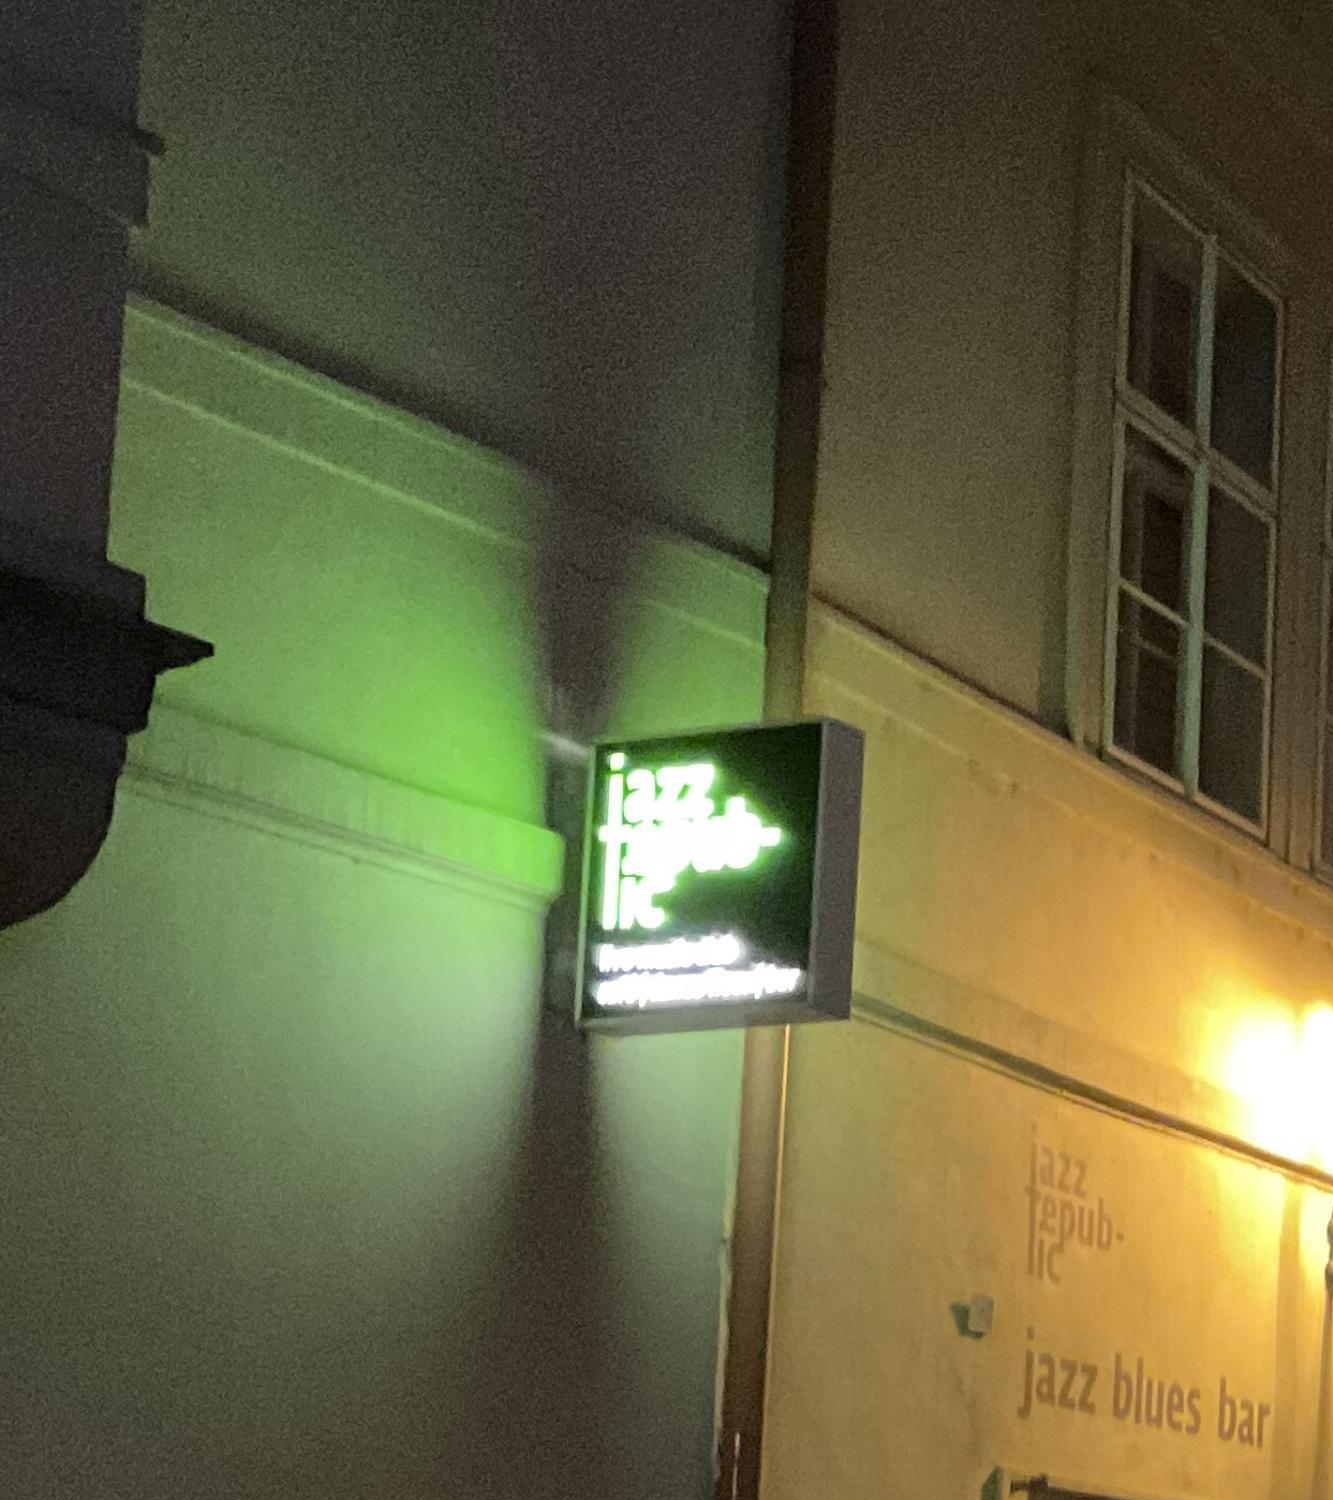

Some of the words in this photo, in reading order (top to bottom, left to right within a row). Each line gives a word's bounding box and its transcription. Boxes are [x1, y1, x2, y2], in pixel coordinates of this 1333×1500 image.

[1028, 1123, 1087, 1198] jazz
[1017, 1326, 1098, 1420] jazz
[1112, 1351, 1201, 1435] blues
[1217, 1376, 1271, 1449] bar
